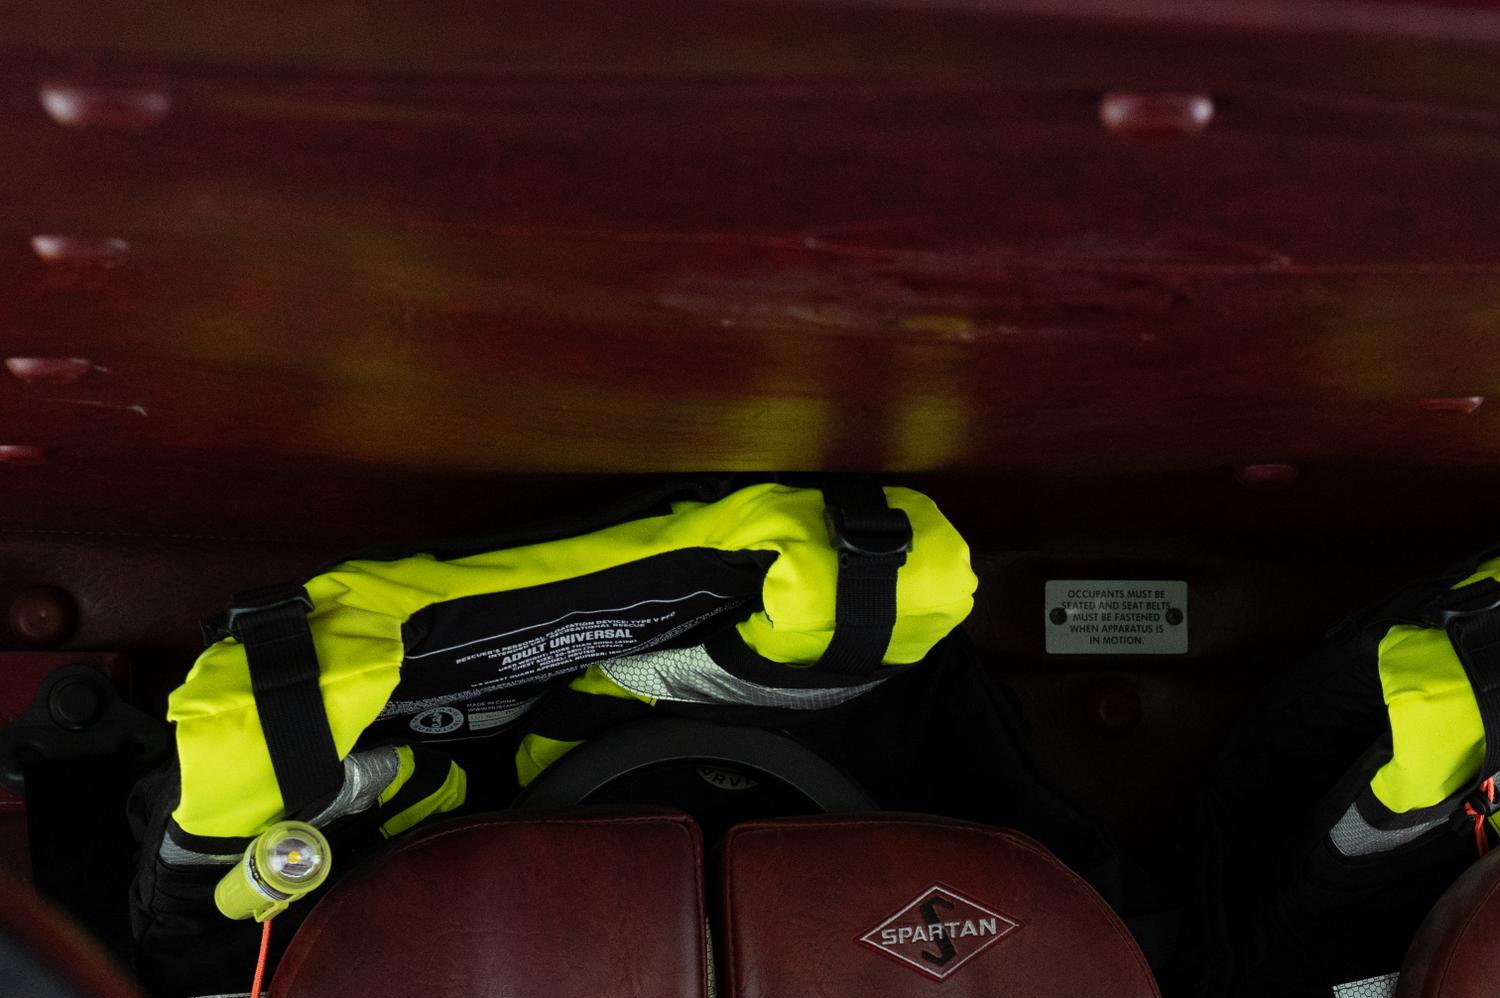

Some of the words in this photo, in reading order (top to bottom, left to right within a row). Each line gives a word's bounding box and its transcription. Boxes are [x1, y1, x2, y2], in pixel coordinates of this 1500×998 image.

[1067, 590, 1124, 598] OCCUPANTS
[1127, 590, 1151, 598] MUST
[1154, 590, 1165, 598] BE
[1062, 601, 1095, 610] SEATED
[1098, 601, 1119, 610] AND
[1122, 601, 1143, 610] SEAT
[1146, 601, 1171, 610] BELTS
[1073, 613, 1098, 621] MUST
[1101, 613, 1111, 621] BE
[1115, 613, 1160, 621] FASTENED
[1070, 624, 1098, 633] WHEN
[1101, 624, 1153, 633] APPARATUS
[1156, 624, 1164, 633] IS
[1090, 636, 1099, 645] IN
[1102, 636, 1144, 645] MOTION.
[500, 642, 548, 665] ADULT
[548, 628, 634, 649] UNIVERSAL
[881, 917, 997, 946] SPARTAN
